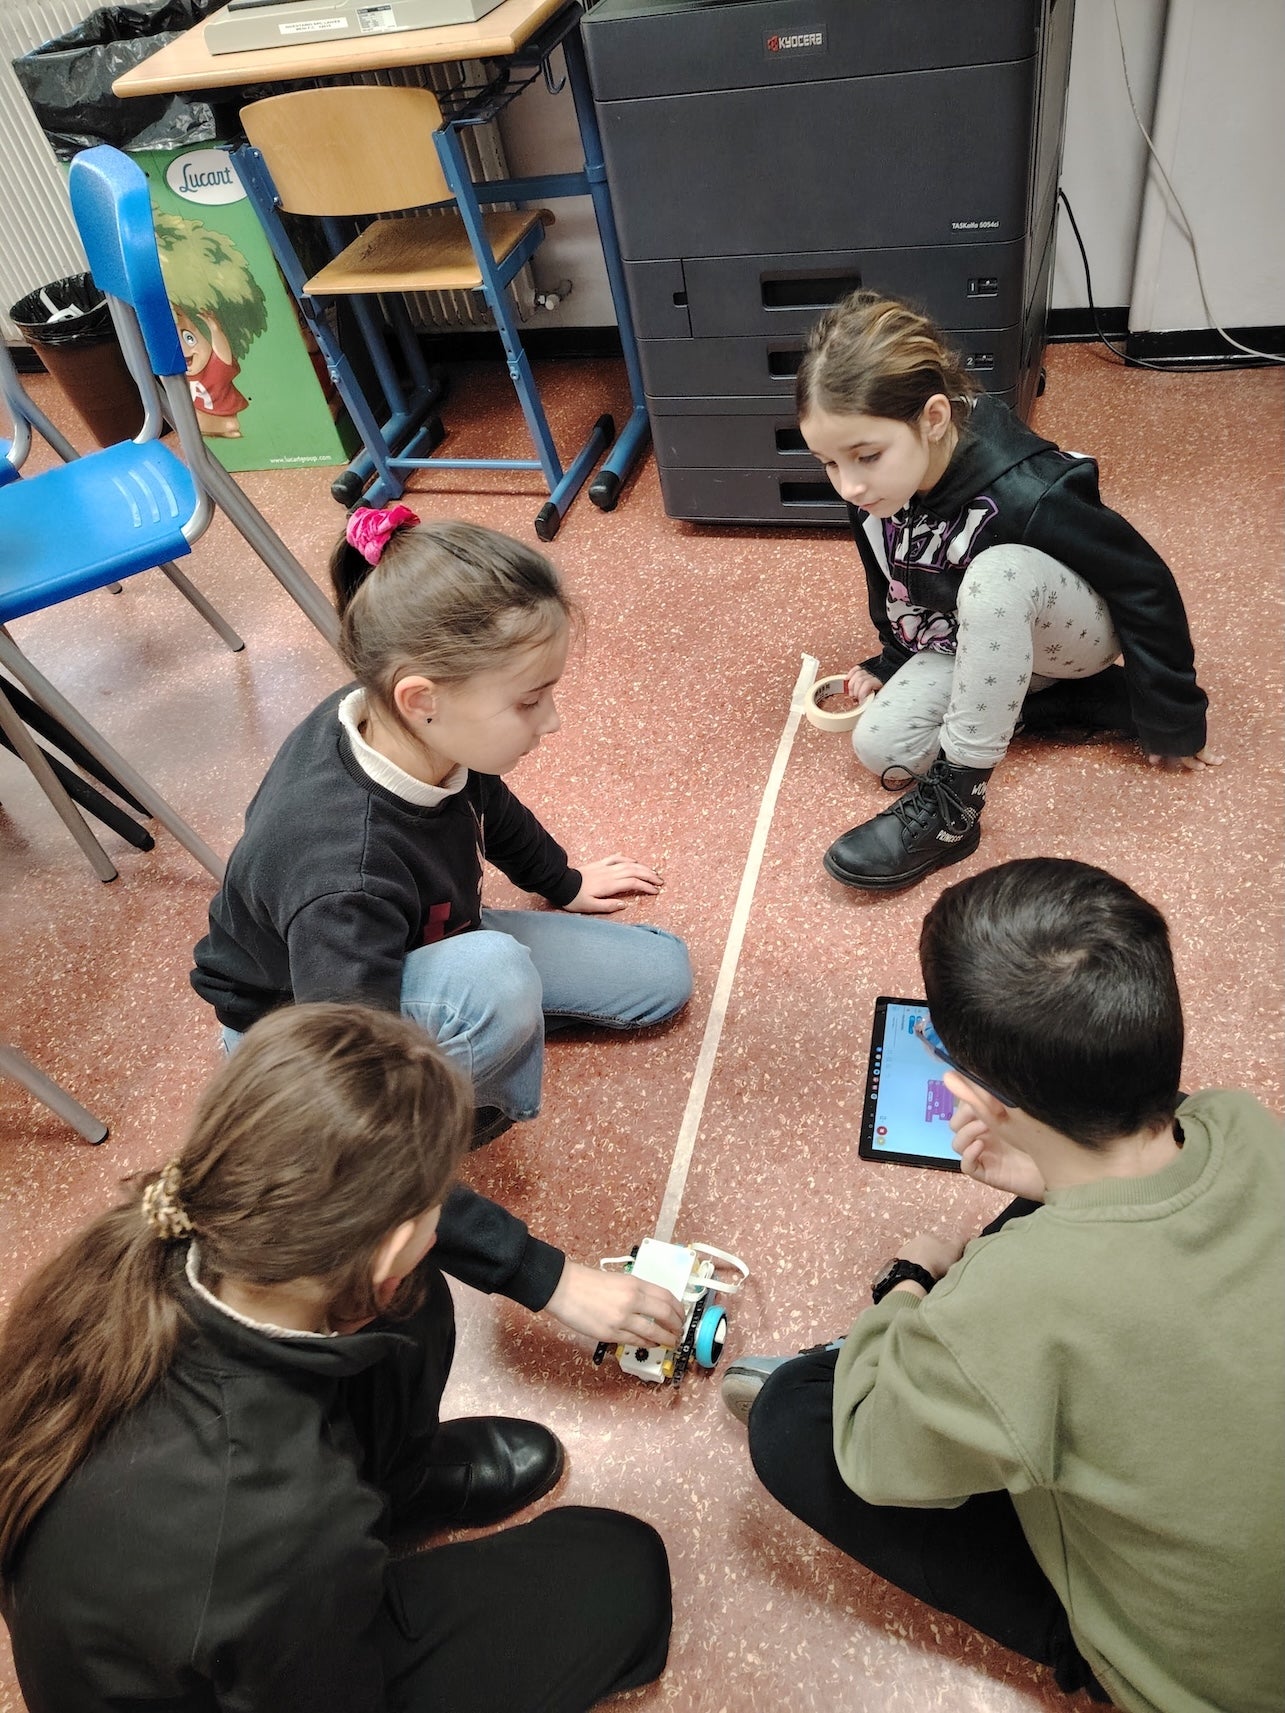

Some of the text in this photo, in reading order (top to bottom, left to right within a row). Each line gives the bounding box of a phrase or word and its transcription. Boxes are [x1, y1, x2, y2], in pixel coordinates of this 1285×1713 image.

[778, 32, 823, 50] KYOCERA
[179, 163, 233, 193] Lucart
[966, 356, 974, 366] 2
